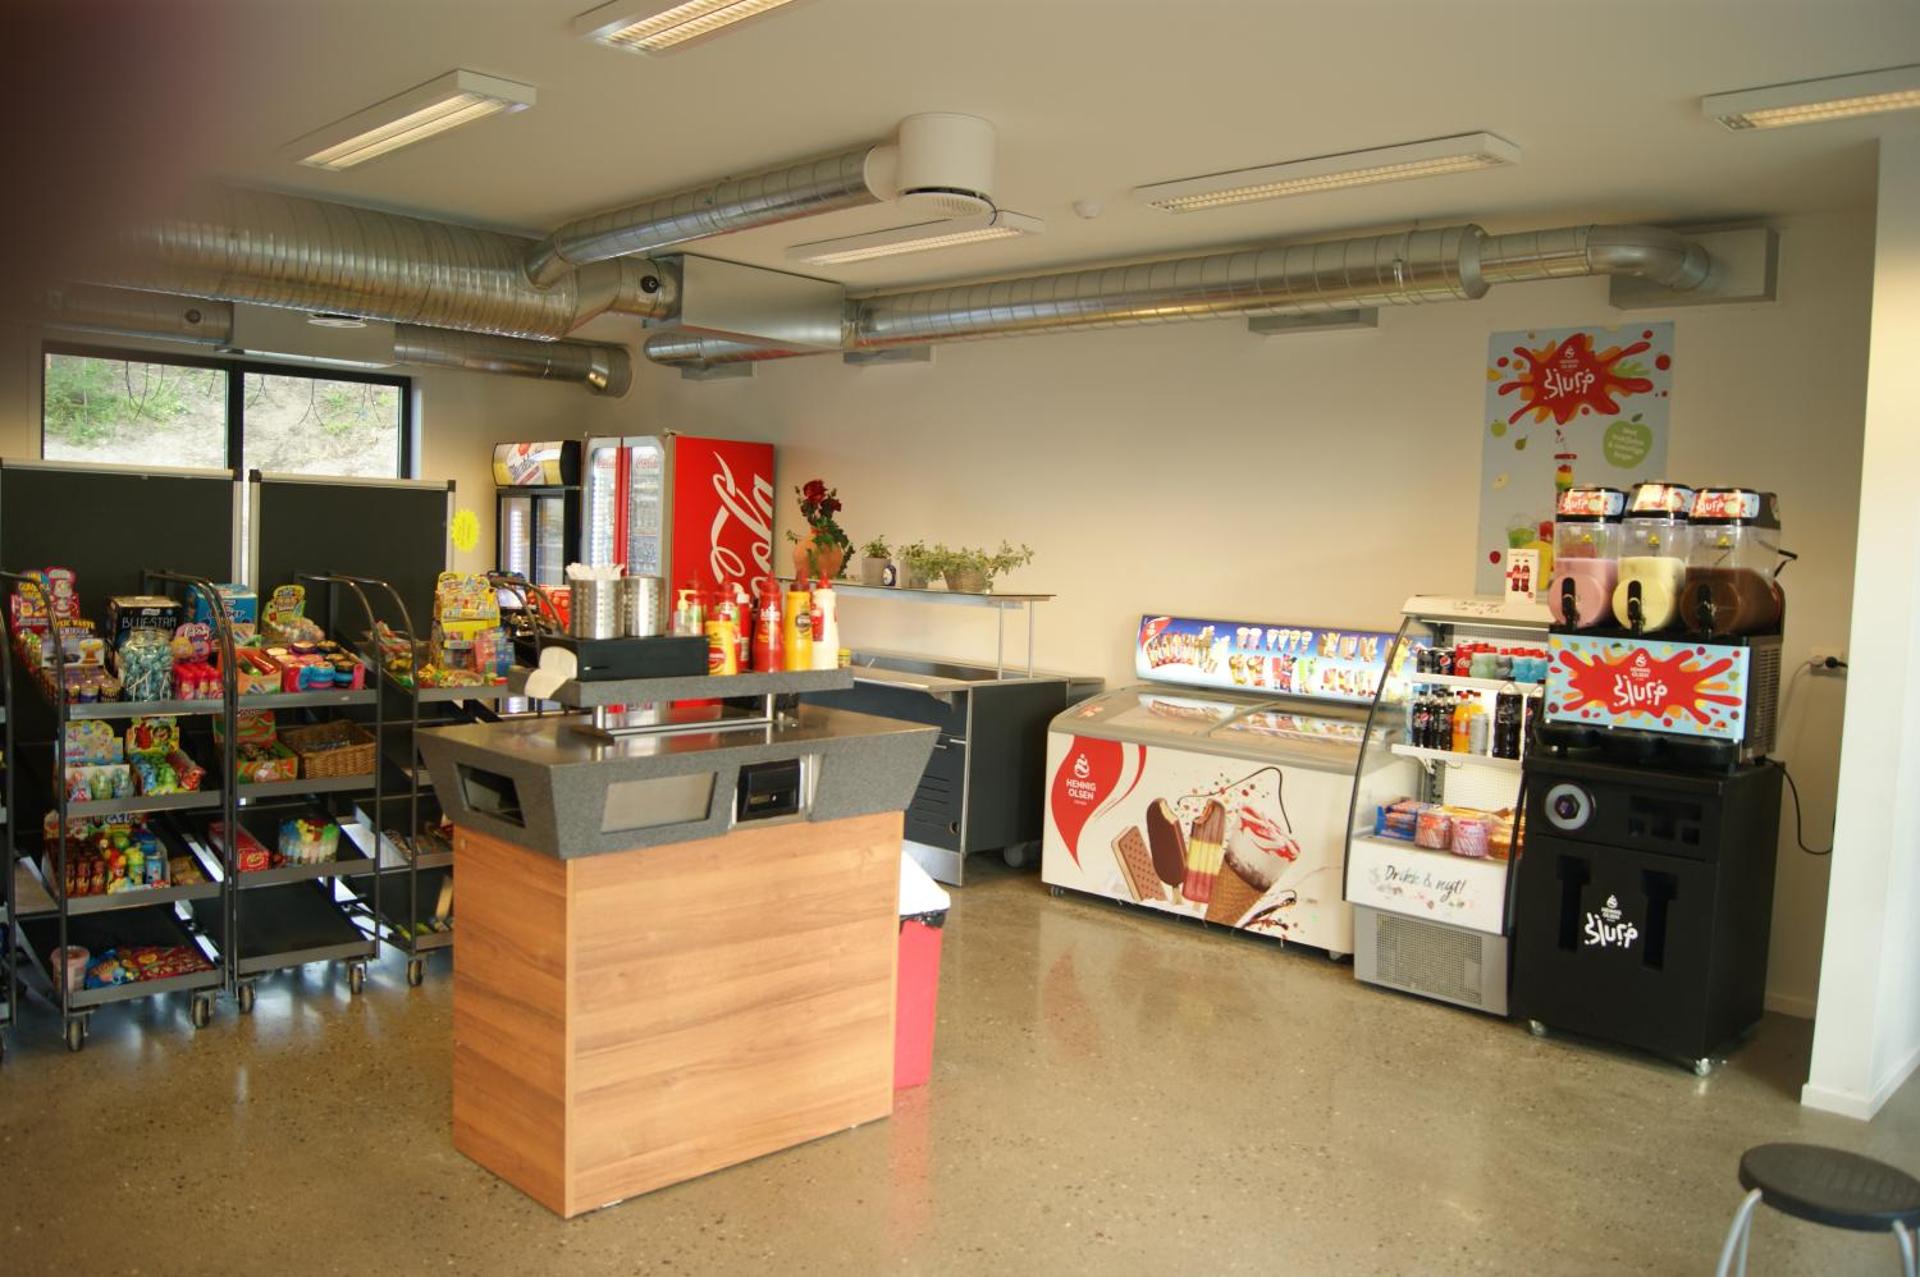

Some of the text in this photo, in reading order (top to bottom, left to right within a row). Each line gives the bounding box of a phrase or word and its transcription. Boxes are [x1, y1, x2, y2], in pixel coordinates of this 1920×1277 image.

[1543, 368, 1595, 400] Slurp
[1613, 674, 1668, 707] Slurp
[1065, 778, 1097, 792] HENNIG
[1068, 788, 1094, 801] OLSEN
[1584, 912, 1638, 948] Slurp
